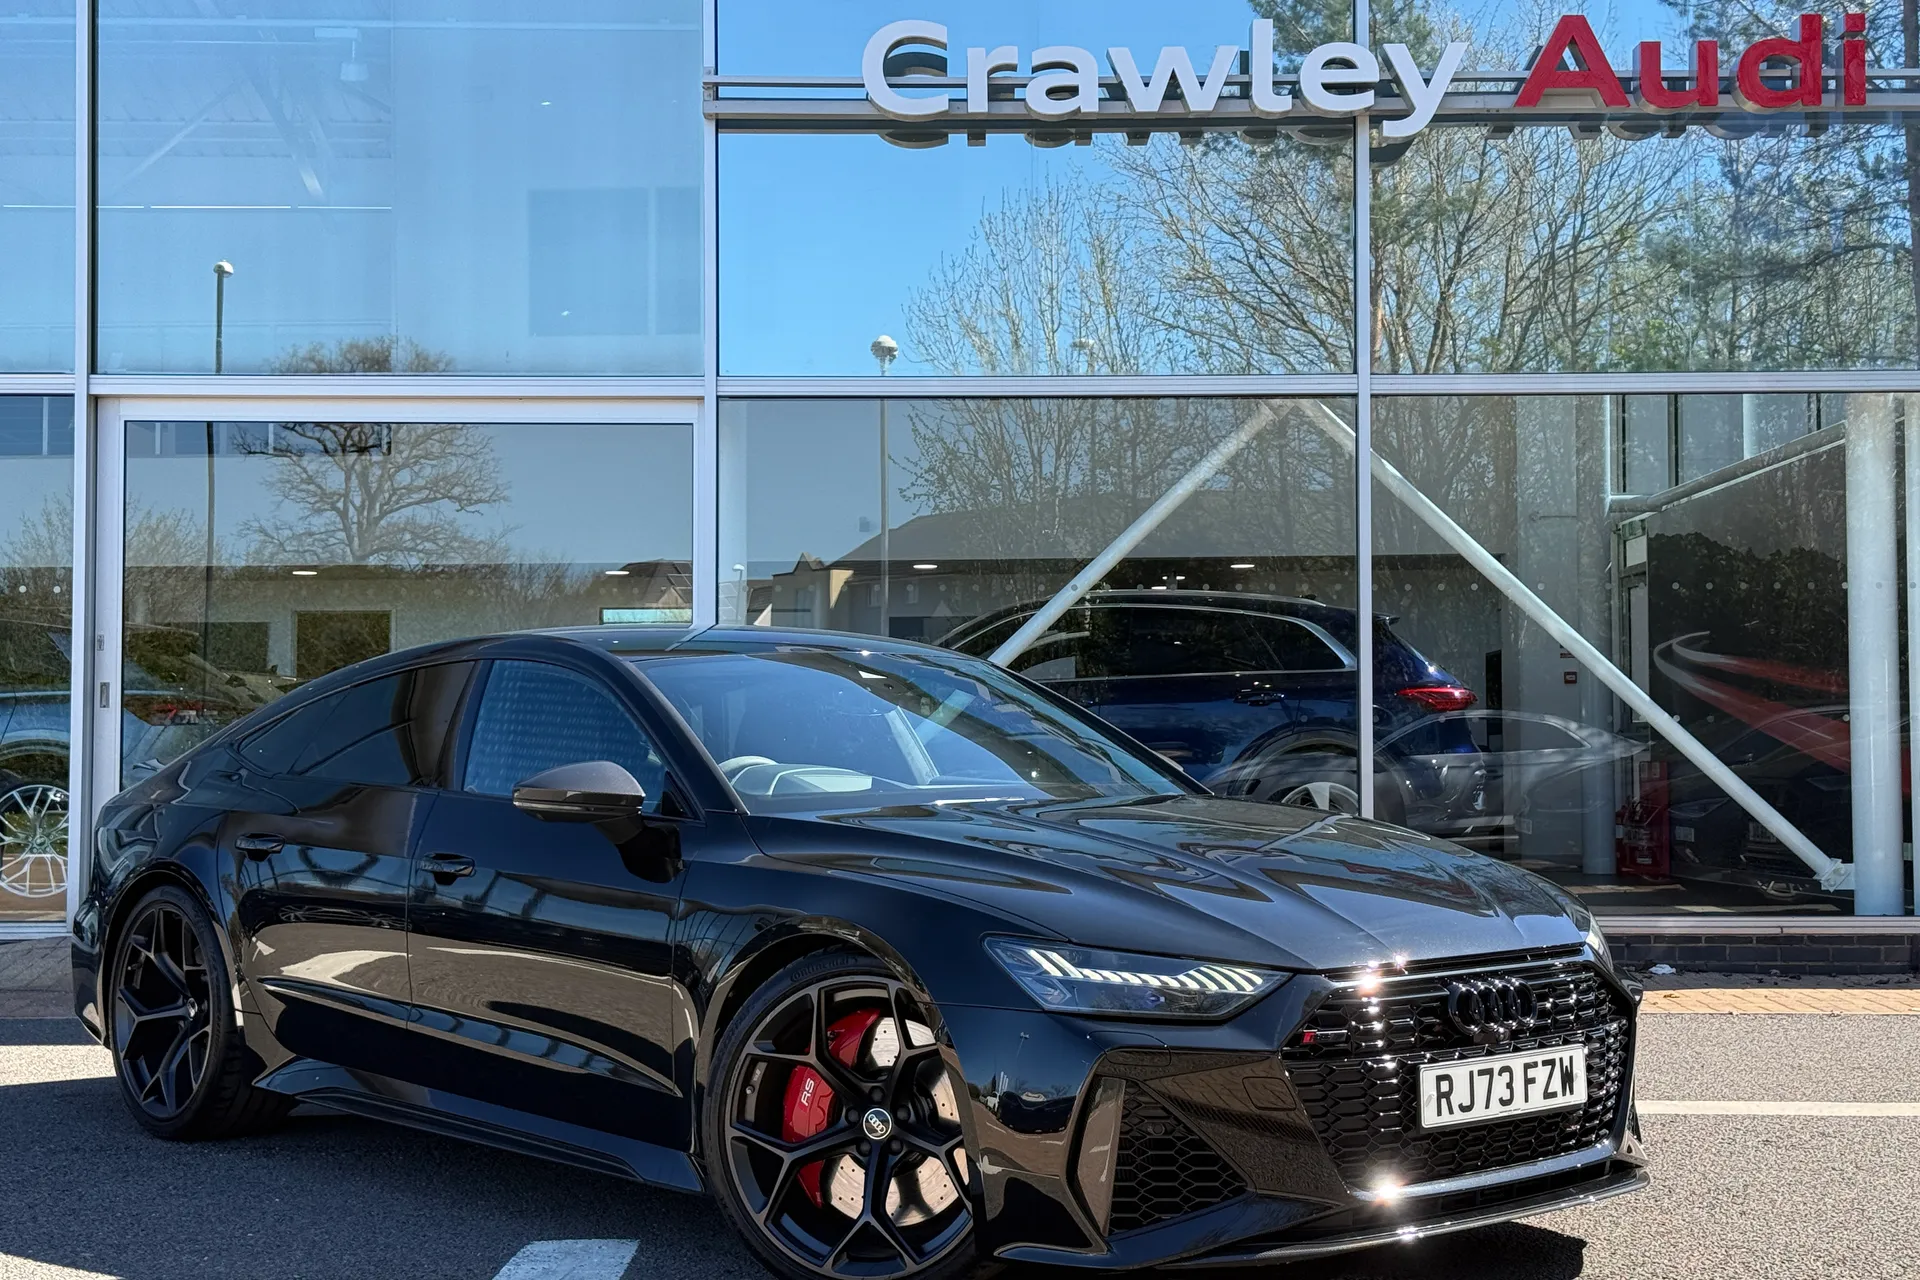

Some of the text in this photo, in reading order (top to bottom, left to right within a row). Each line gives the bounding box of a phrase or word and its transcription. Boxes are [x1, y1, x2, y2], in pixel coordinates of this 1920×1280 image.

[862, 13, 1867, 137] Crawley Audi
[801, 1077, 815, 1107] RS
[1435, 1055, 1575, 1117] RJ73 FZW
